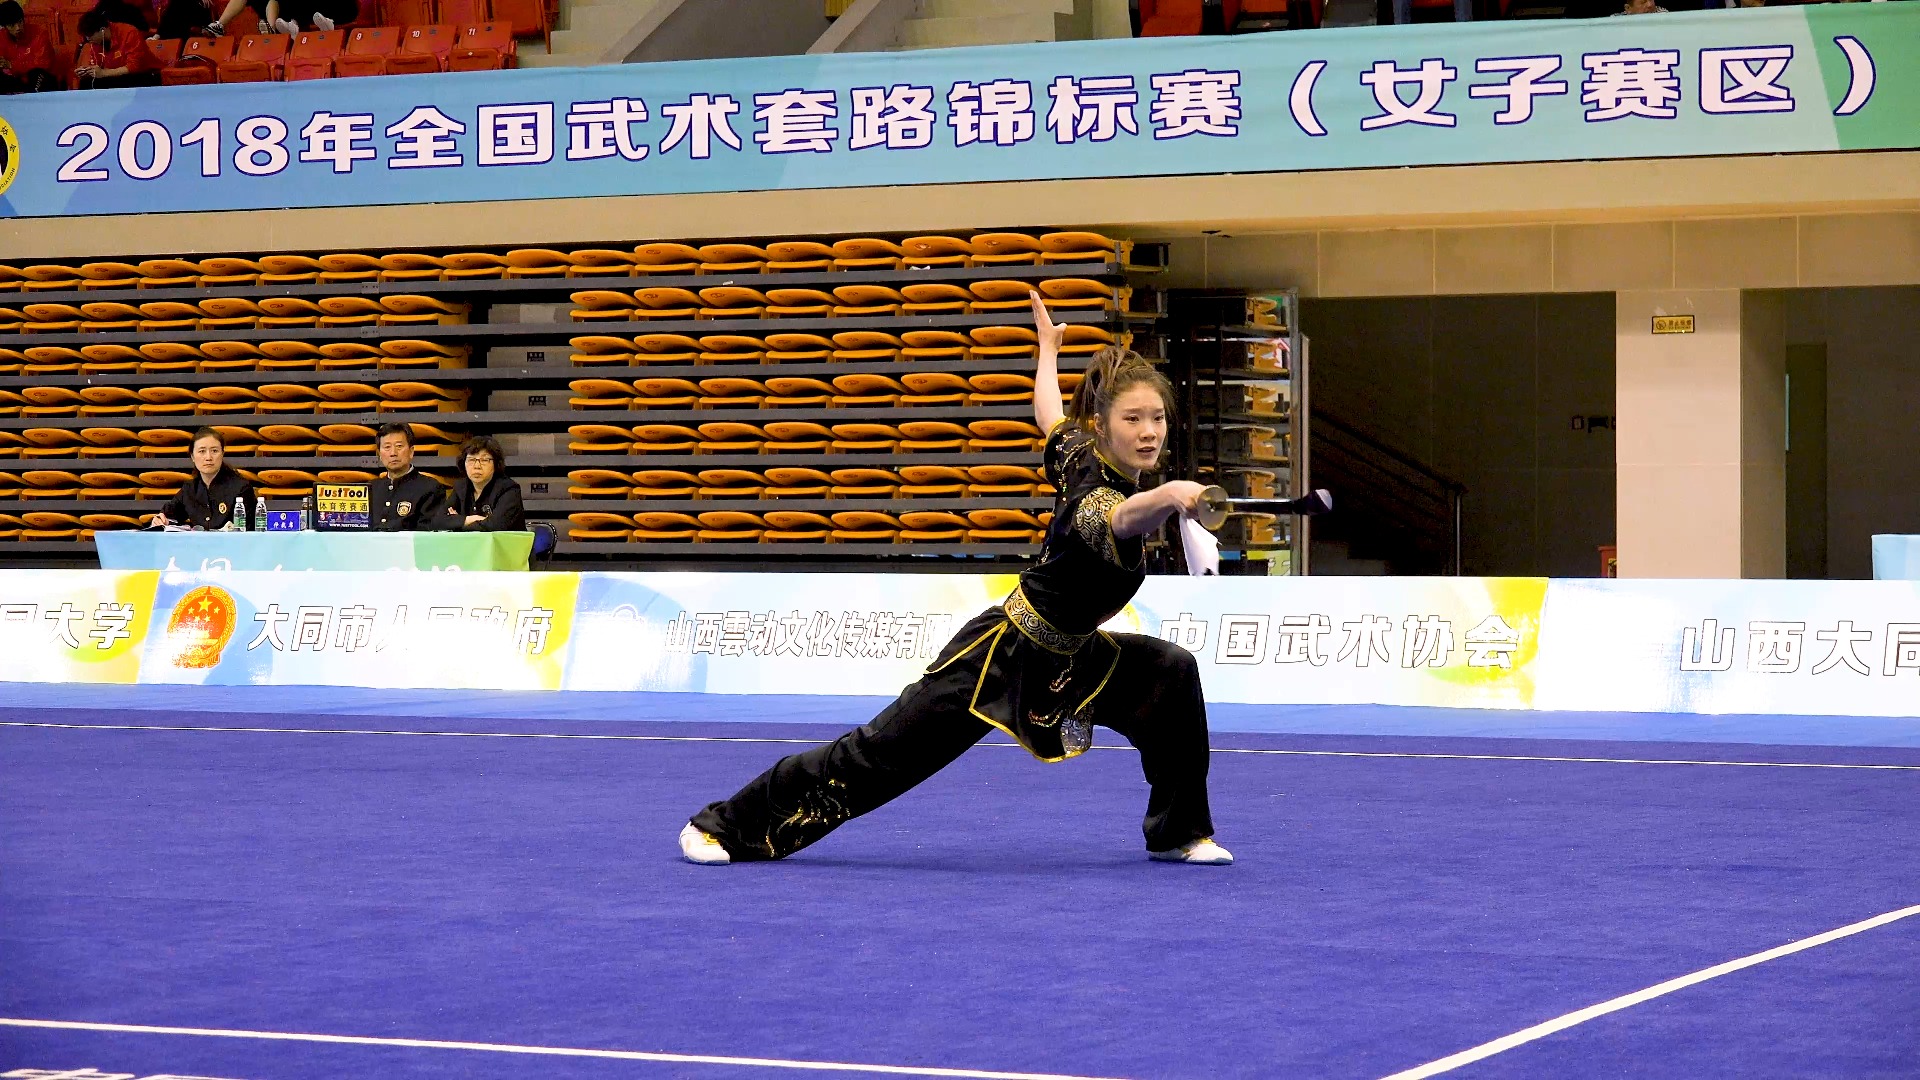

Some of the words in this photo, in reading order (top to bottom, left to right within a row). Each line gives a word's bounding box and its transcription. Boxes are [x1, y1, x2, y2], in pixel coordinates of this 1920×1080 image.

[411, 29, 421, 38] 10
[468, 27, 476, 36] 11
[301, 36, 308, 44] 8
[356, 32, 363, 41] 9
[192, 41, 199, 50] 6
[247, 39, 254, 48] 7
[318, 486, 368, 498] JustTool
[1159, 612, 1520, 669] 中国武术协会
[1680, 618, 1920, 677] 山西大同
